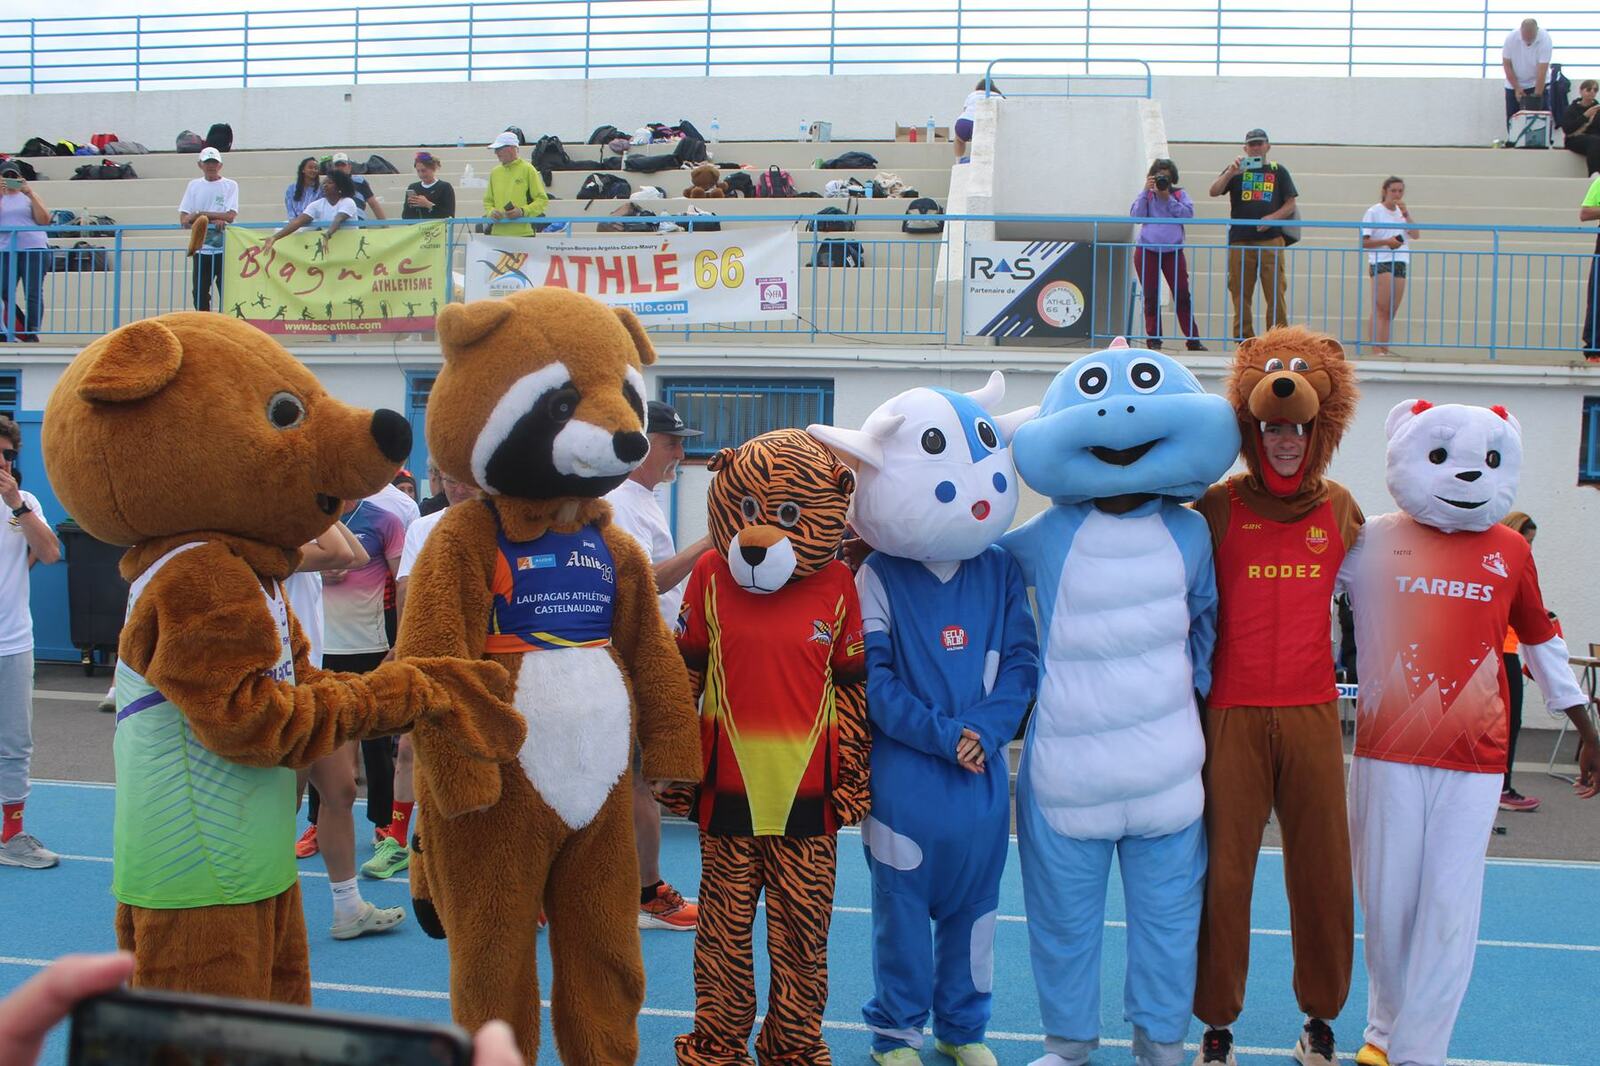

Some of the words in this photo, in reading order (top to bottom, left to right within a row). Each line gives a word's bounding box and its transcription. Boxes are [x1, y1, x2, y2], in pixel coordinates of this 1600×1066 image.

[239, 246, 432, 295] Blagnac
[544, 243, 679, 295] ATHLÉ
[694, 246, 745, 289] 66
[372, 277, 433, 293] ATHLETISME
[970, 286, 1005, 294] Partenaire
[1006, 286, 1016, 294] de
[284, 320, 382, 332] www.bsc-athle.com
[1248, 565, 1321, 579] RODEZ
[1395, 576, 1494, 602] TARBES
[516, 591, 571, 605] LAURAGAIS
[572, 590, 612, 604] ATHLÉTISME
[534, 604, 604, 615] CASTELNAUDARY
